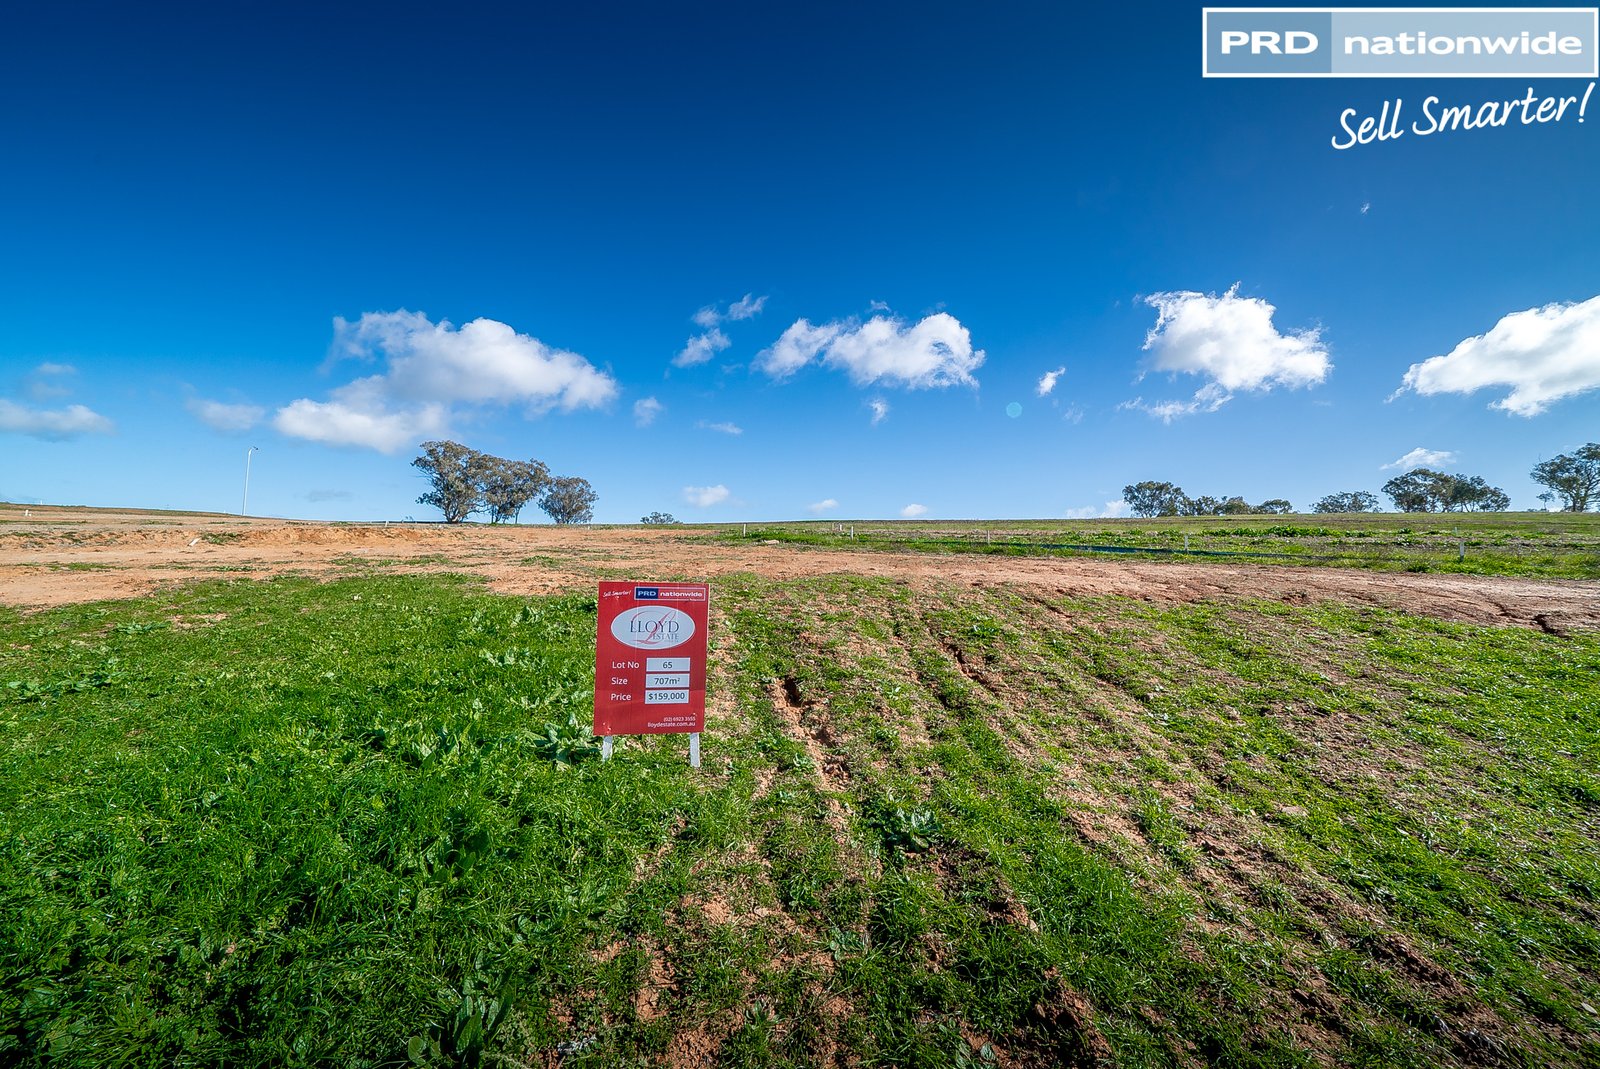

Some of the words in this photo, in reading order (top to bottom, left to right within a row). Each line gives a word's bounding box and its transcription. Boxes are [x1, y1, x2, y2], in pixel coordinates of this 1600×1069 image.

[660, 590, 703, 598] nationwide
[630, 620, 680, 633] LLOYD
[612, 661, 626, 669] Lot
[627, 661, 640, 669] No
[662, 661, 673, 669] 65
[611, 677, 628, 685] Size
[610, 693, 632, 701] Price
[648, 692, 686, 701] $159,000
